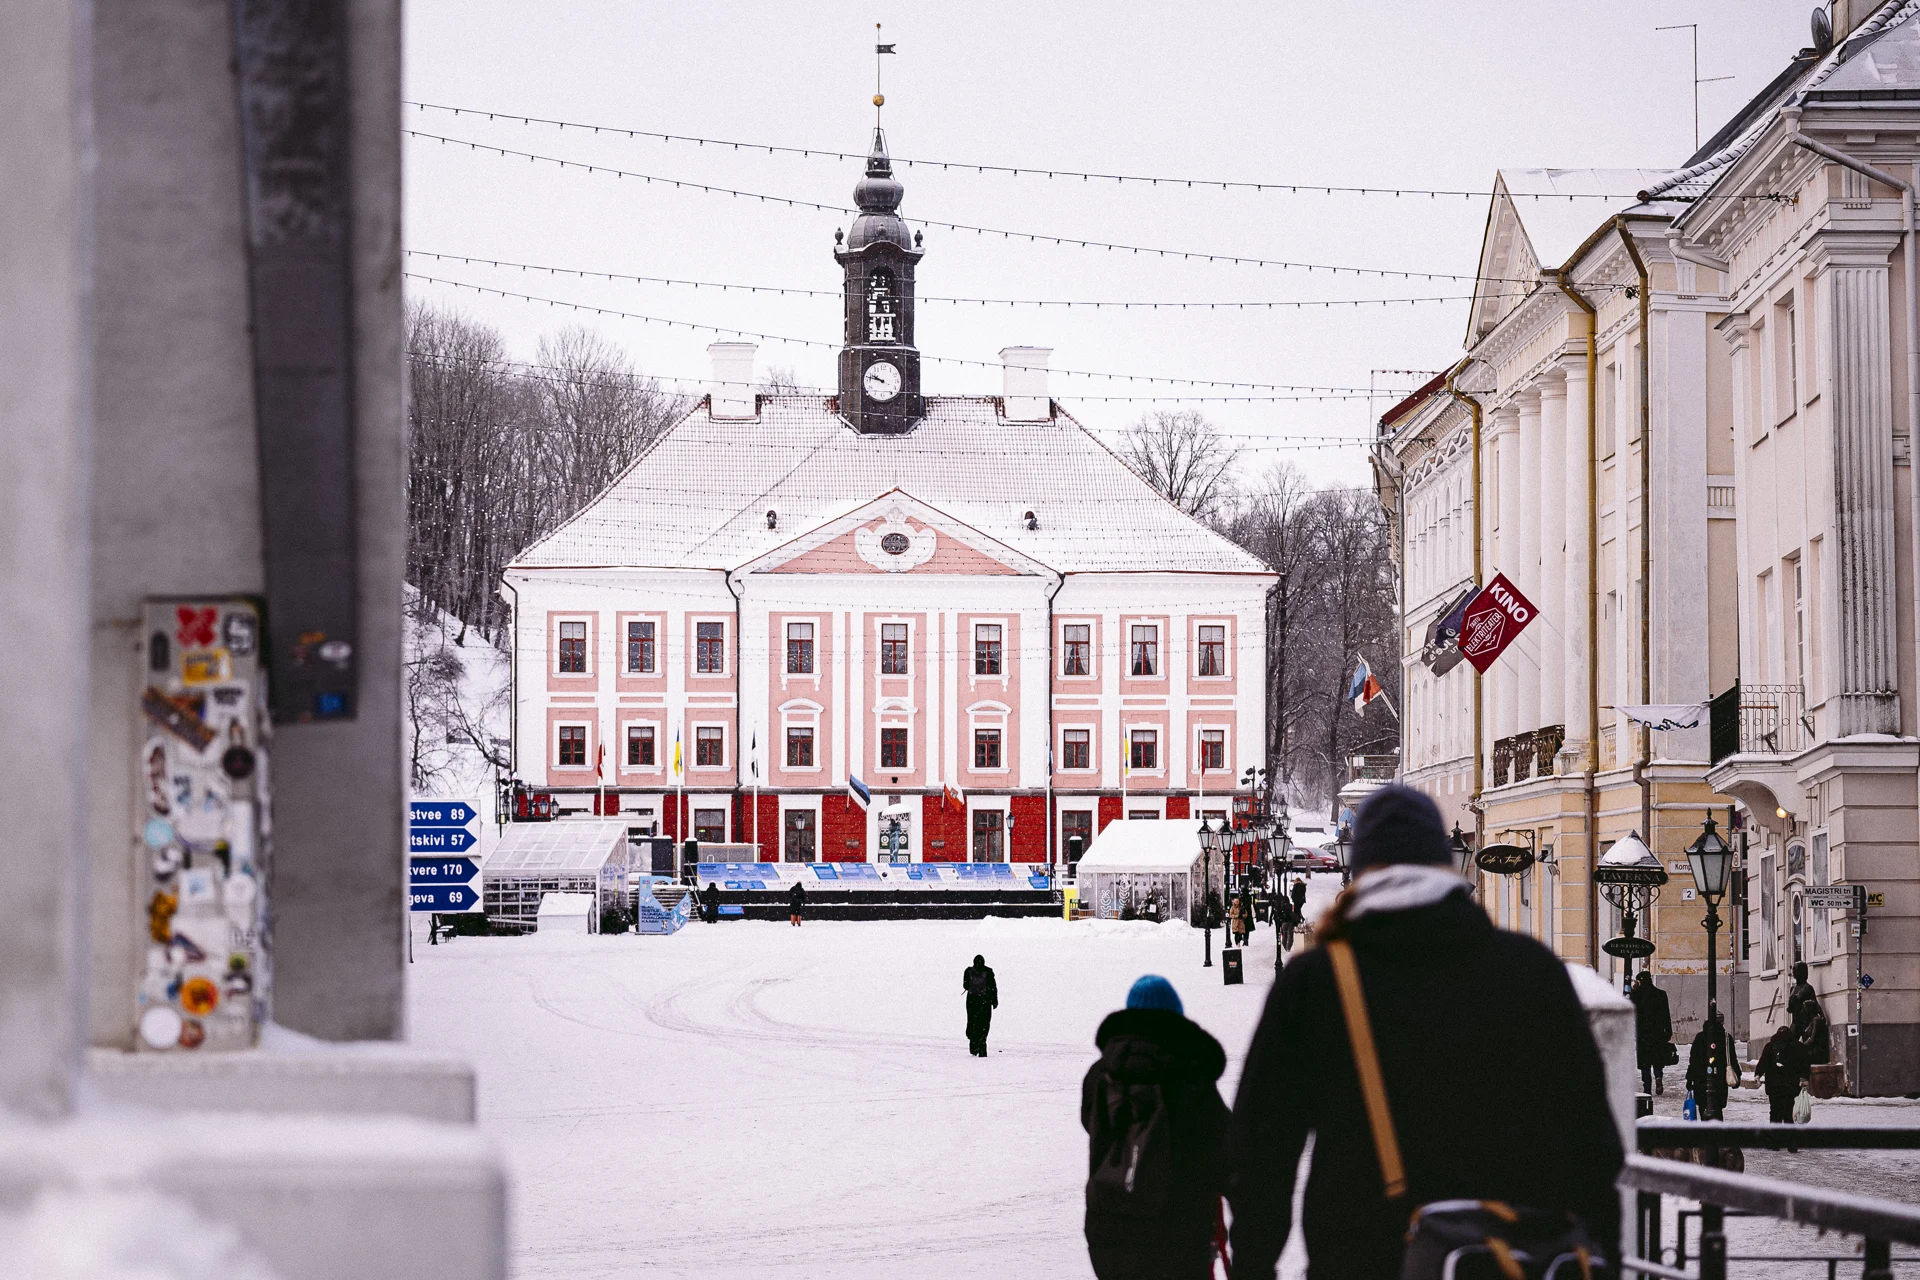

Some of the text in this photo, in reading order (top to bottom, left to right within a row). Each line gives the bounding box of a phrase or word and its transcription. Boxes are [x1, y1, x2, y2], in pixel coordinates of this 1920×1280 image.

[1489, 582, 1529, 623] KINO
[1469, 615, 1481, 629] TARTU
[1465, 612, 1503, 653] ELEKTRITEATER
[450, 808, 465, 820] 89
[450, 834, 465, 846] 57
[442, 864, 463, 876] 170
[1600, 872, 1661, 882] TAVERNA
[1686, 890, 1692, 899] 2
[1804, 887, 1842, 895] MAGISTRI
[408, 891, 463, 906] geva 69
[1868, 893, 1883, 902] WC
